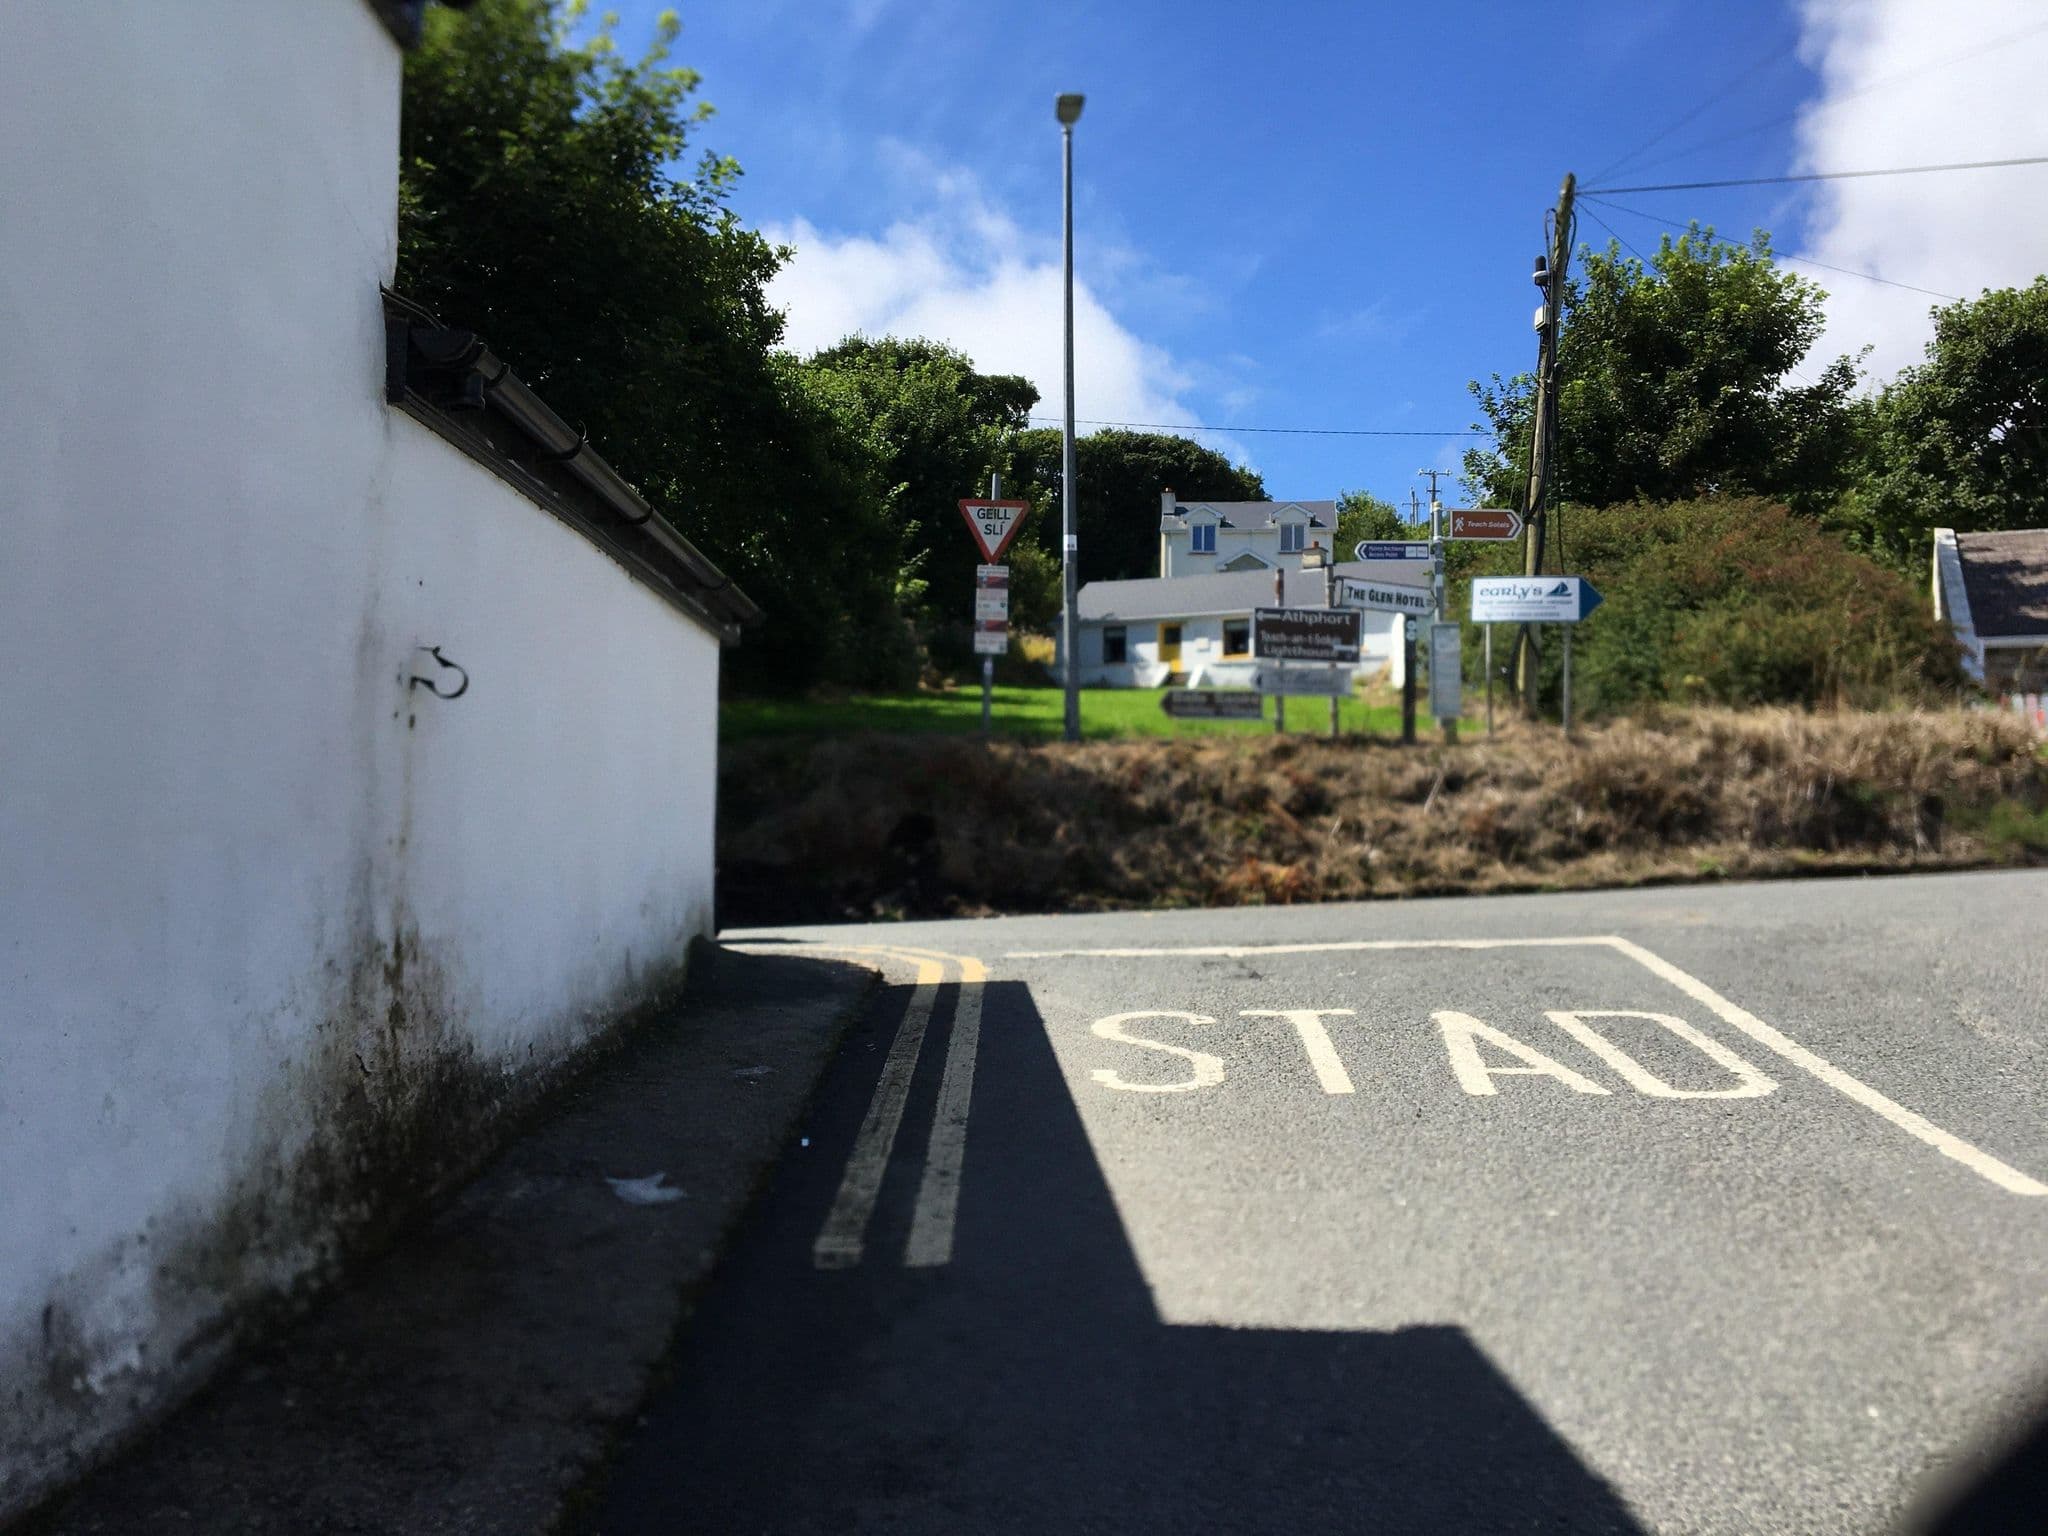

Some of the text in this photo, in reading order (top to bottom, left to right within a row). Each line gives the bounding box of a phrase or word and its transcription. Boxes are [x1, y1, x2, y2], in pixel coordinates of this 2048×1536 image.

[977, 508, 1011, 520] GEILL
[984, 521, 1005, 535] SLÍ
[1347, 586, 1425, 608] THE GLEN HOTEL
[1282, 610, 1351, 626] Athphort
[1089, 1008, 1779, 1100] STAD
